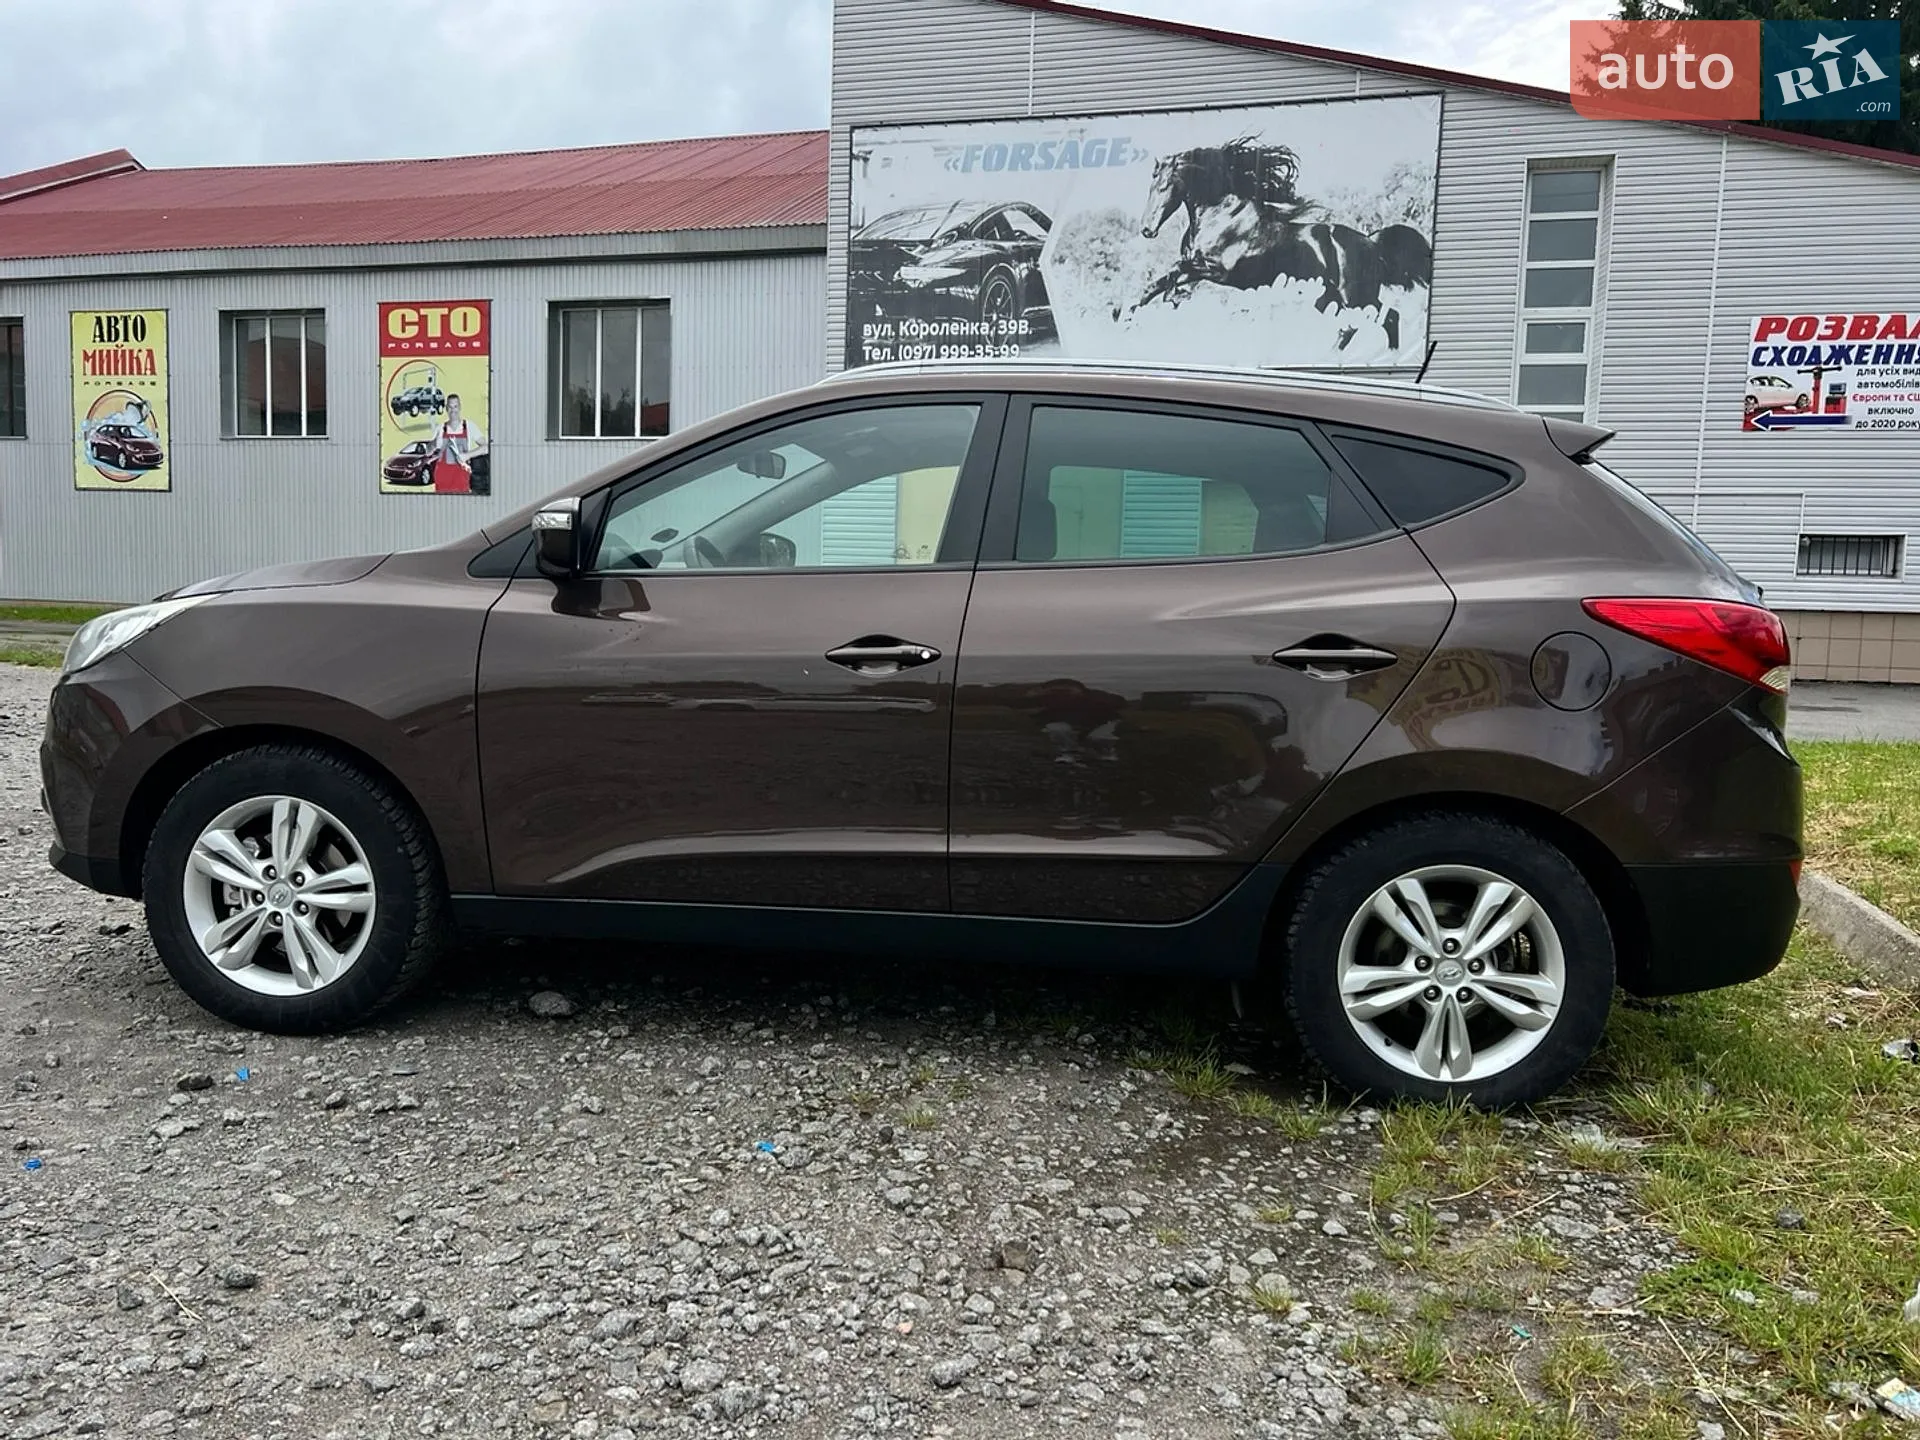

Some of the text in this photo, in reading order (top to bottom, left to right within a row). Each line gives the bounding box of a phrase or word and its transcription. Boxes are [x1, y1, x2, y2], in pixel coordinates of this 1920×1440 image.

[387, 305, 482, 339] СТО
[92, 314, 147, 344] АВТО
[863, 323, 895, 340] вул.
[899, 320, 995, 339] Короленка,
[387, 341, 481, 350] FORSAGE
[862, 344, 1020, 361] Тел. (097) 999-35-99
[82, 344, 158, 377] МИЙКА
[1856, 368, 1876, 377] для
[1878, 366, 1900, 378] усіх
[1856, 379, 1920, 389] автомобілів
[1852, 393, 1891, 403] Європи
[1893, 394, 1905, 402] та
[1867, 407, 1915, 415] включно
[1855, 421, 1869, 429] до
[1870, 419, 1896, 428] 2020
